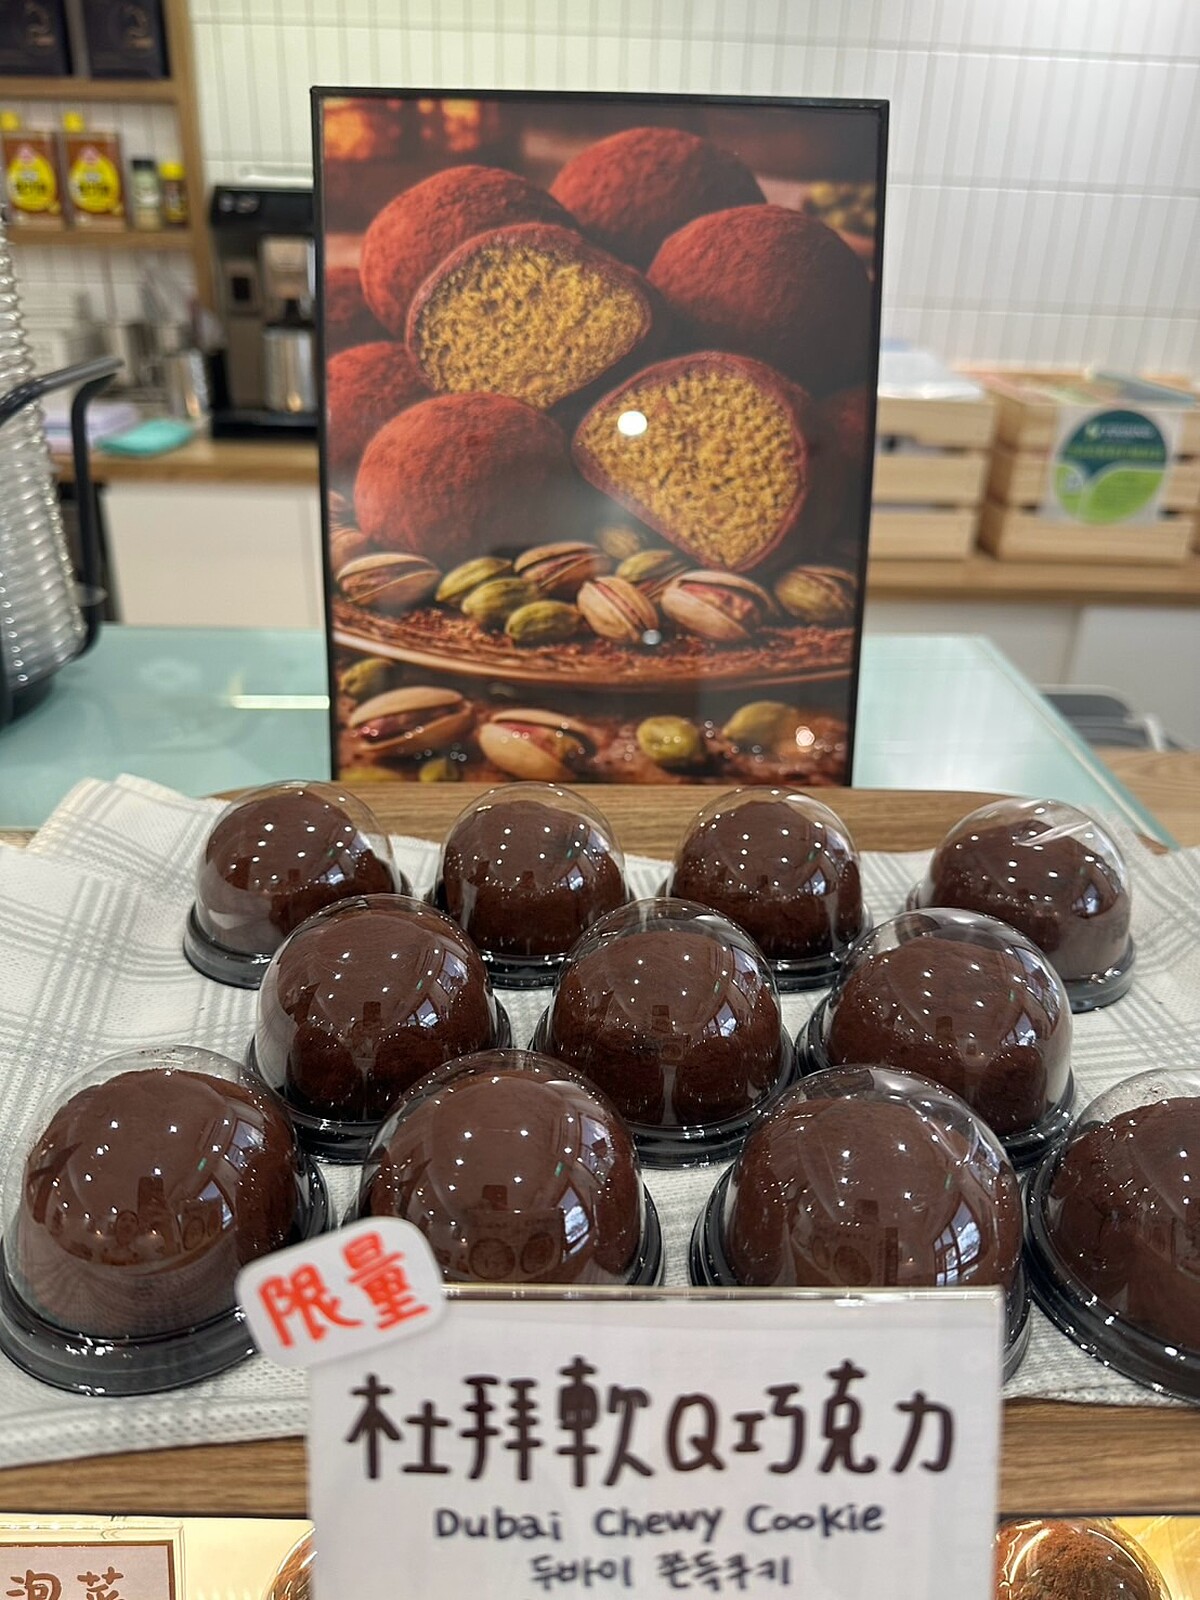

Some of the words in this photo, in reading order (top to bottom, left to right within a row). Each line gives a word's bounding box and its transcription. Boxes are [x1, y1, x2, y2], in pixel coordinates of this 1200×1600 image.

[258, 1231, 429, 1349] 限量
[345, 1356, 955, 1489] 杜拜軟Q巧克力
[434, 1507, 562, 1541] Dubai
[594, 1508, 723, 1543] Chewy
[746, 1503, 885, 1538] Cookie
[531, 1554, 632, 1591] 두바이
[656, 1551, 790, 1592] 쫀득쿠키
